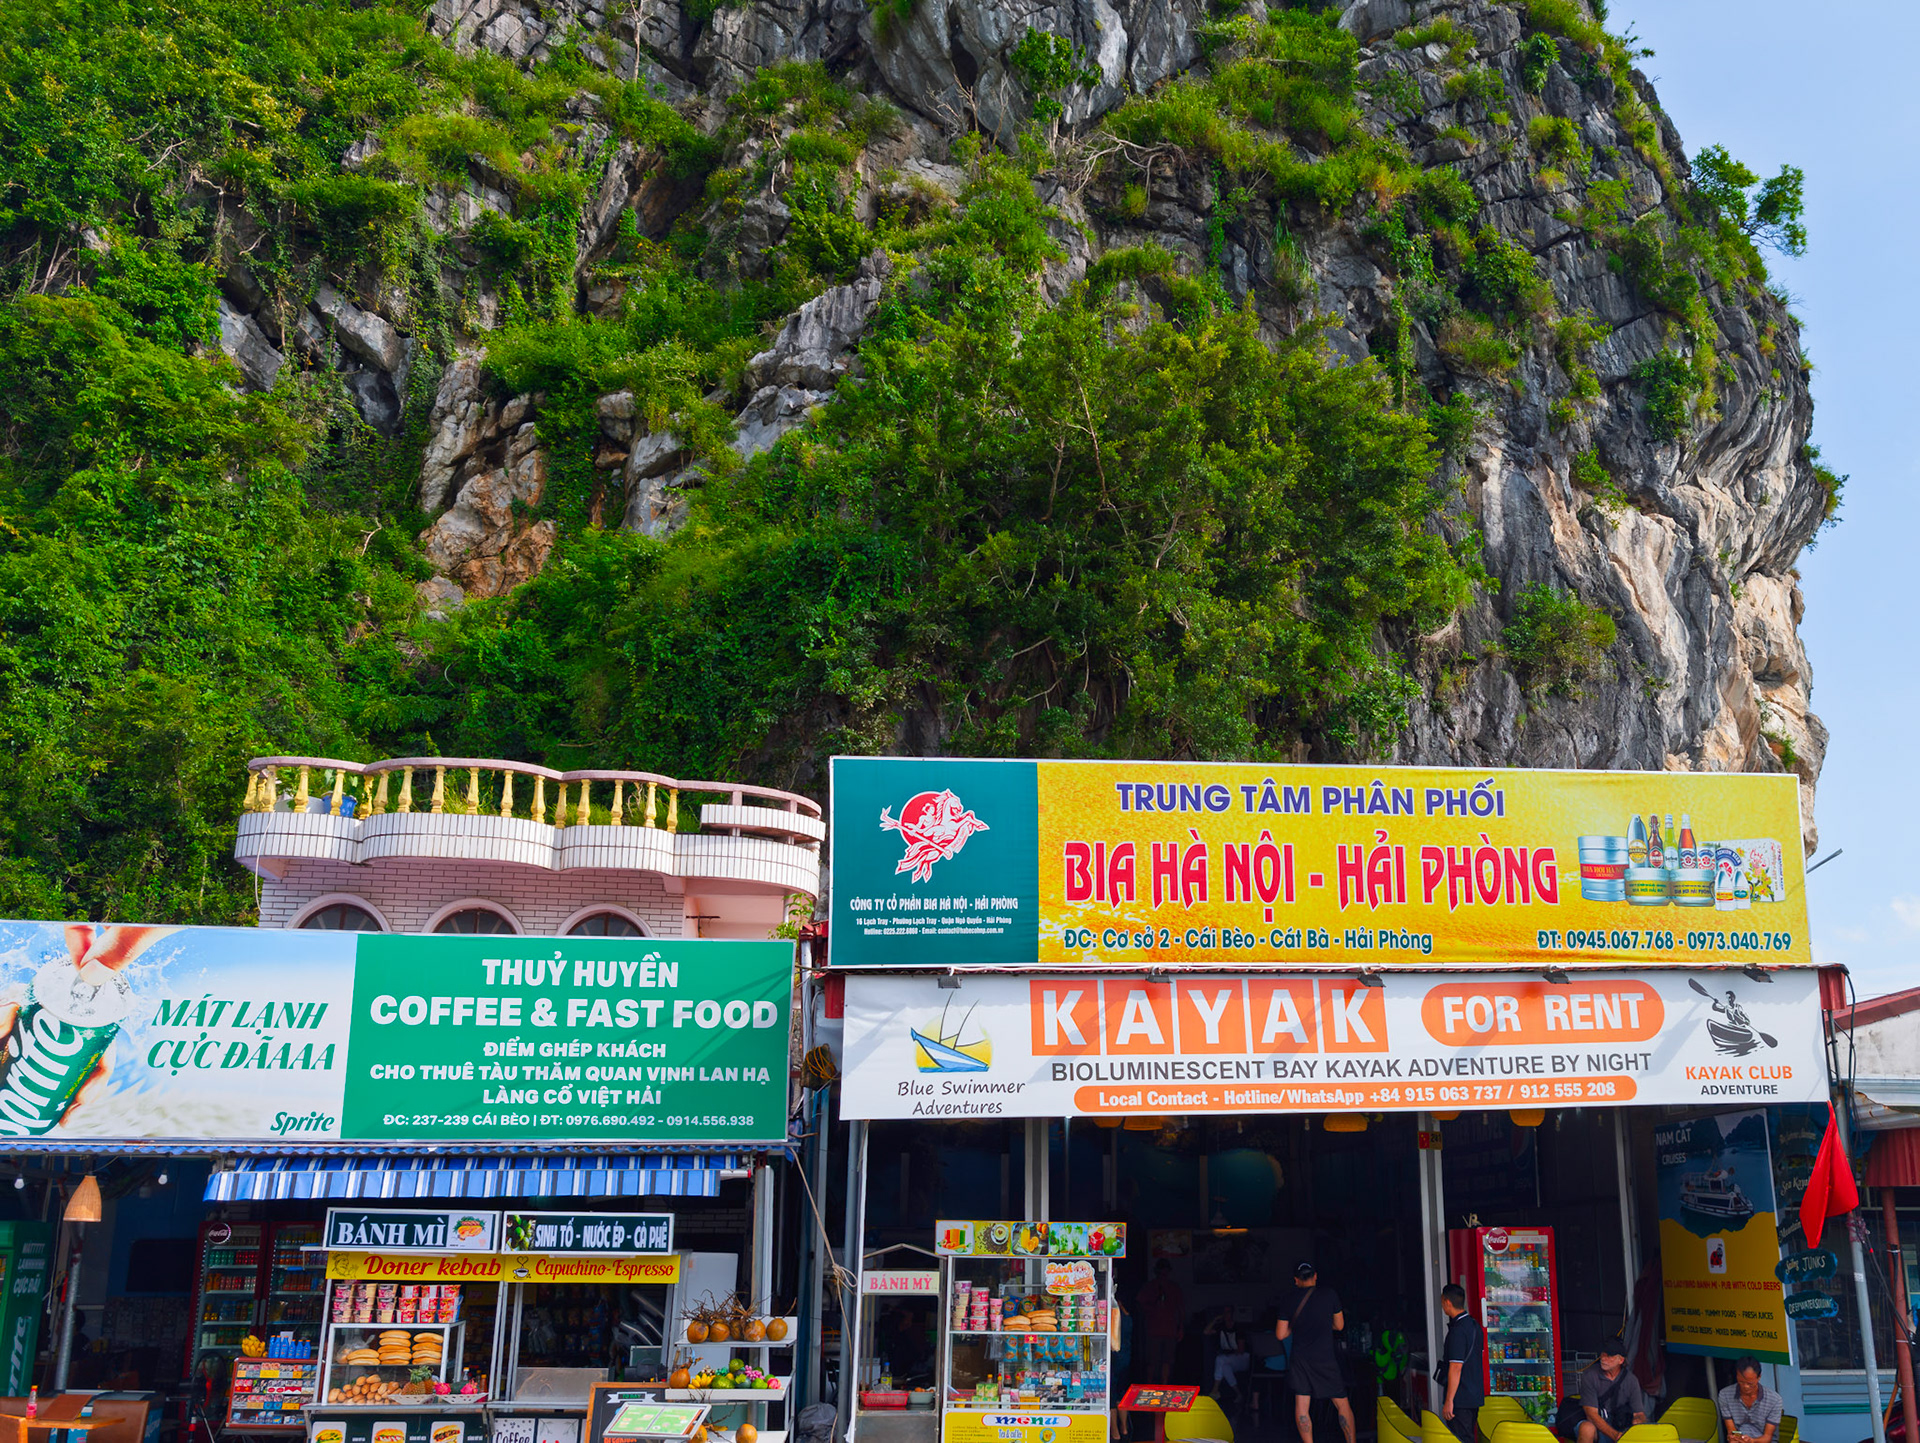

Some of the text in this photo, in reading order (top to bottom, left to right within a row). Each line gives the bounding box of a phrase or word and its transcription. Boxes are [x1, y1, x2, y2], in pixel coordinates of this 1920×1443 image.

[1117, 778, 1505, 817] TRUNG TÂM PHÂN PHỐI
[1065, 828, 1558, 923] BIA HÀ NỘI HẢI PHÒNG
[850, 893, 1018, 913] CÔNG TY CỔ PHẦN BIA HÀ NỘI HẢI PHÒNG
[1064, 925, 1792, 955] ĐC: Cơ sở 2 Cái Bèo Cát Bà Hải Phòng ĐT: 0945.067.768 0973.040.769
[482, 951, 679, 988] THUỶ HUYỀN
[152, 993, 329, 1035] MÁT LẠNH
[370, 995, 778, 1029] COFFEE & FAST FOOD
[1044, 988, 1644, 1046] KAYAK FOR RENT
[147, 1031, 335, 1076] CỰC ĐÃAAA
[483, 1036, 666, 1059] ĐIỂM GHÉP KHÁCH
[370, 1061, 770, 1086] CHO THUÊ TÀU THĂM QUAN VỊNH LAN HẠ
[1052, 1053, 1651, 1081] BIOLUMINESCENT BAY KAYAK ADVENTURE BY NIGHT
[1685, 1065, 1793, 1080] KAYAK CLUB
[483, 1083, 661, 1108] LÀNG CỔ VIỆT HẢI
[898, 1079, 1025, 1096] Blue Swimmer
[1099, 1082, 1616, 1107] Local Contact Hotline/WhatsApp +84 915 063 737 912 555 208
[1701, 1084, 1778, 1096] ADVENTURE
[913, 1099, 1002, 1116] Adventures
[270, 1111, 335, 1136] Sprite
[383, 1112, 754, 1127] ĐC: 237-239 CÁI BÈO ĐT: 0976.690.492 0914.556.938
[1656, 1128, 1692, 1146] NAM CAT
[1662, 1152, 1687, 1165] CRUISES
[338, 1216, 446, 1247] BÁNH MÌ
[535, 1217, 668, 1249] SINH TỐ NƯỚC ÉP CÀ PHÊ
[363, 1255, 501, 1277] Doner kebab
[535, 1259, 675, 1278] Capuchino-Espresso
[1046, 1263, 1073, 1274] Bánh
[1802, 1255, 1826, 1272] JUNKS
[870, 1273, 932, 1290] BÁNH MỲ
[1747, 1281, 1762, 1290] COLD
[1763, 1282, 1781, 1291] BEERS
[1742, 1311, 1757, 1319] FRESH
[995, 1416, 1059, 1426] menu
